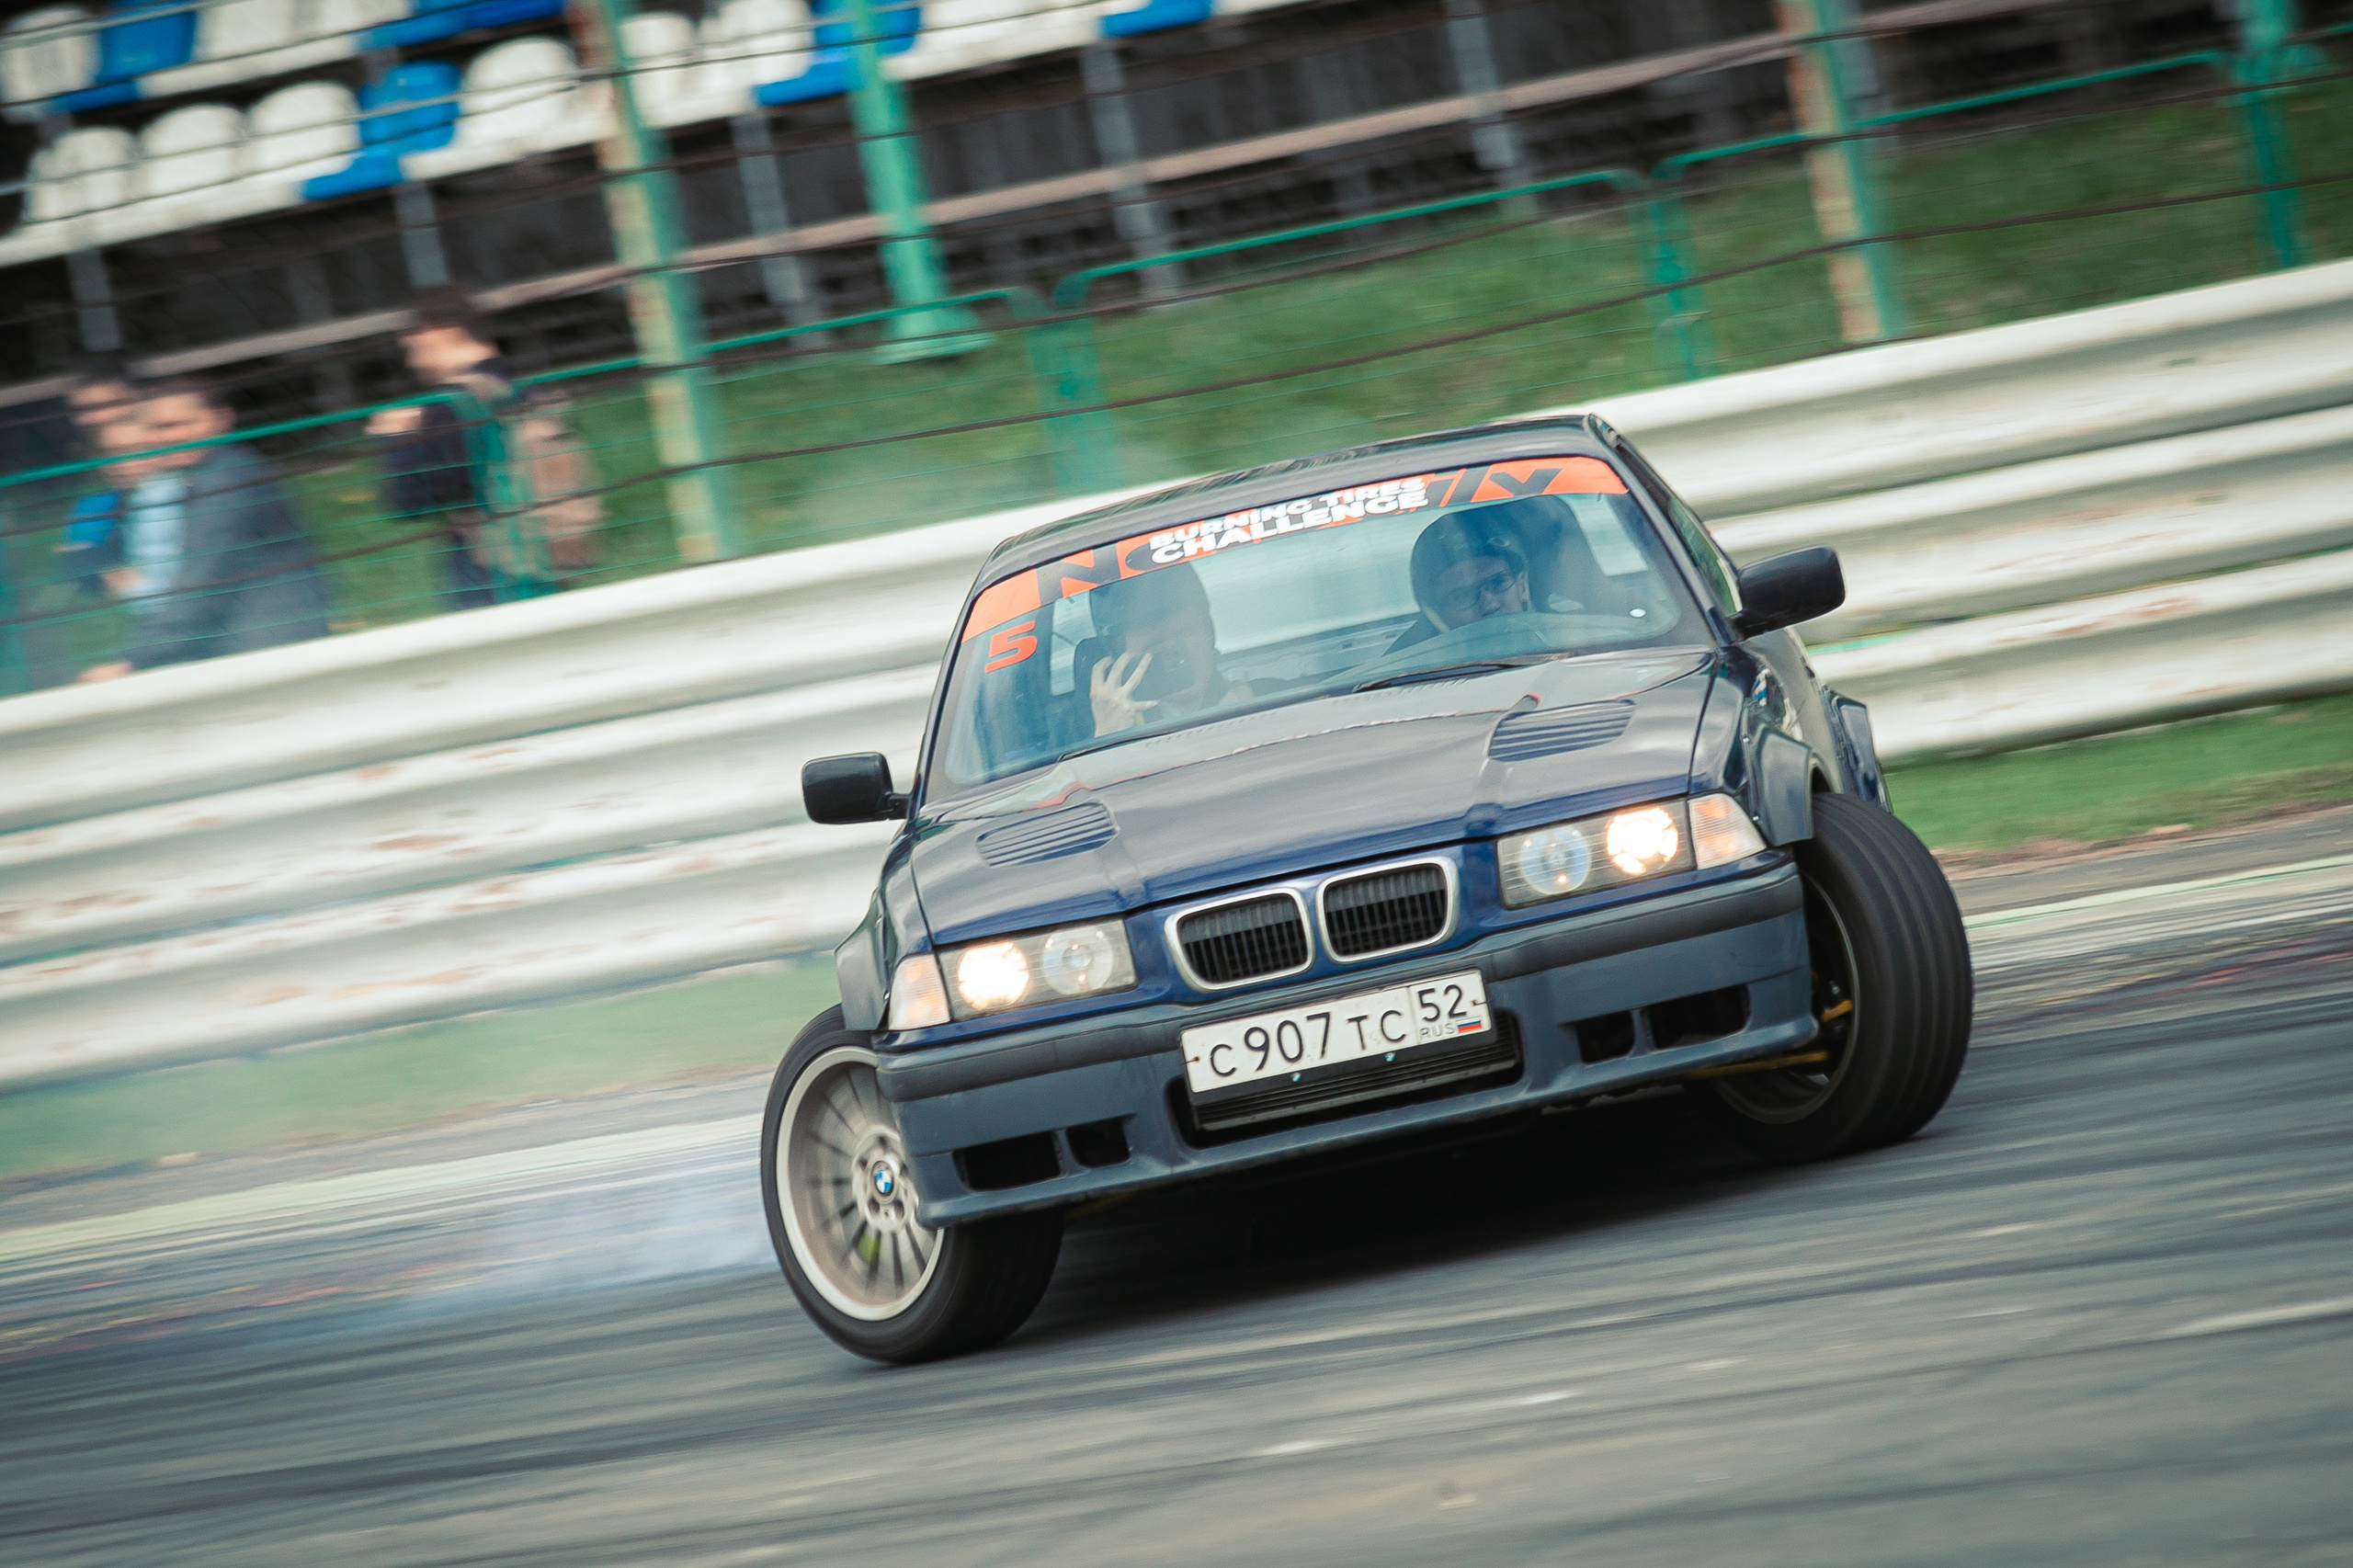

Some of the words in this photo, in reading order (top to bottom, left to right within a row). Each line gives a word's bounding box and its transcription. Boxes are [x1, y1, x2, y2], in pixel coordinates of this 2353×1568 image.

[1149, 498, 1313, 551] BURNING
[1318, 477, 1426, 506] TIRES
[1151, 490, 1429, 564] CHALLENGE
[983, 619, 1038, 674] 5
[1417, 983, 1468, 1023] 52
[1419, 1022, 1457, 1041] RUS
